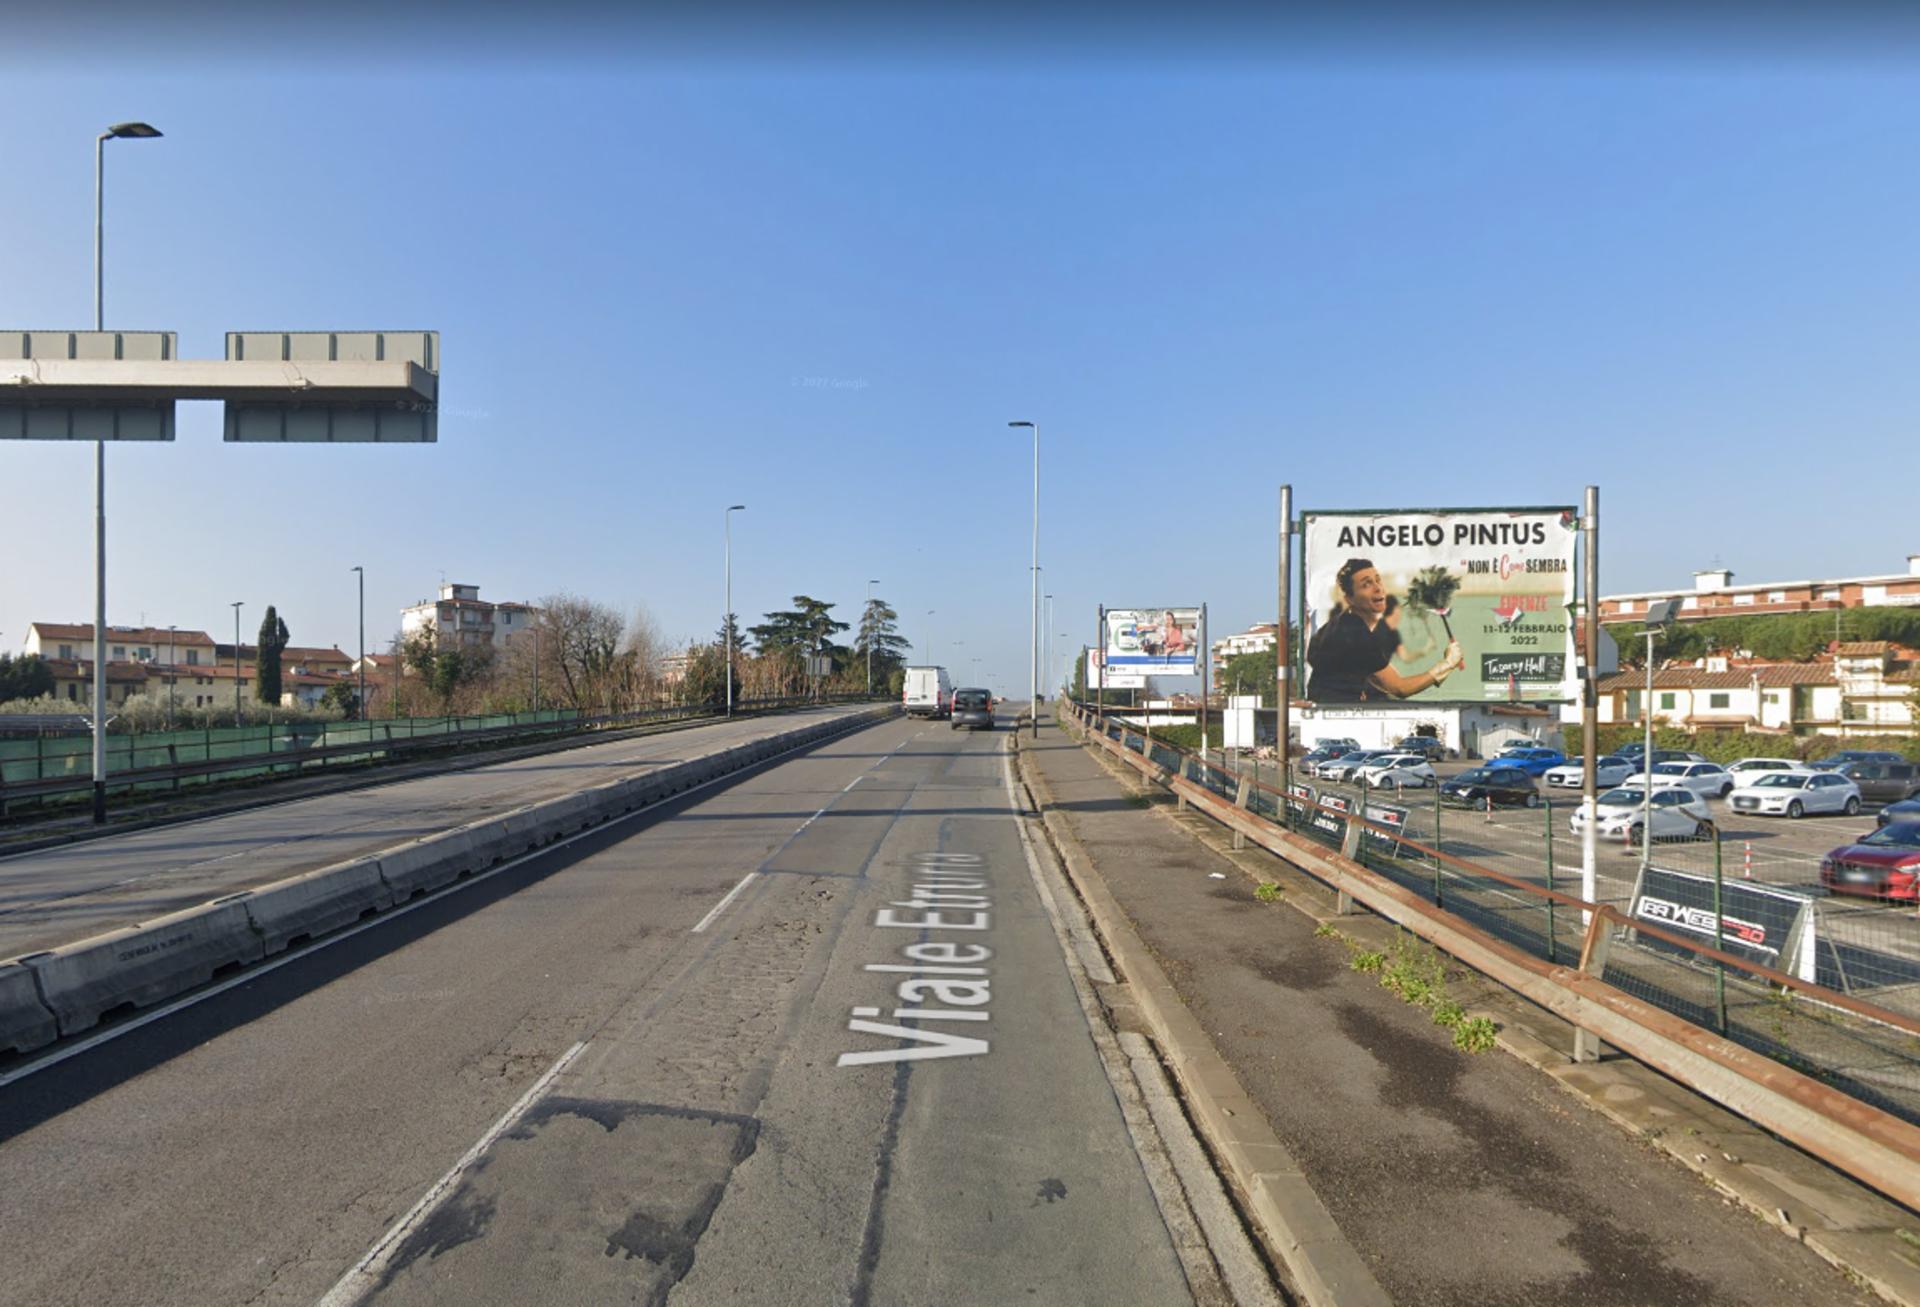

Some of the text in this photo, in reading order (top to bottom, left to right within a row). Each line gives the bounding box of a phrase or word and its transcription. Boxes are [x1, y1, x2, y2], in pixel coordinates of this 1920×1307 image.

[1337, 522, 1546, 547] ANGELO PINTUS
[1525, 559, 1567, 573] SEMBRA
[1512, 624, 1567, 634] FEBBRAIO
[1510, 636, 1538, 645] 2022
